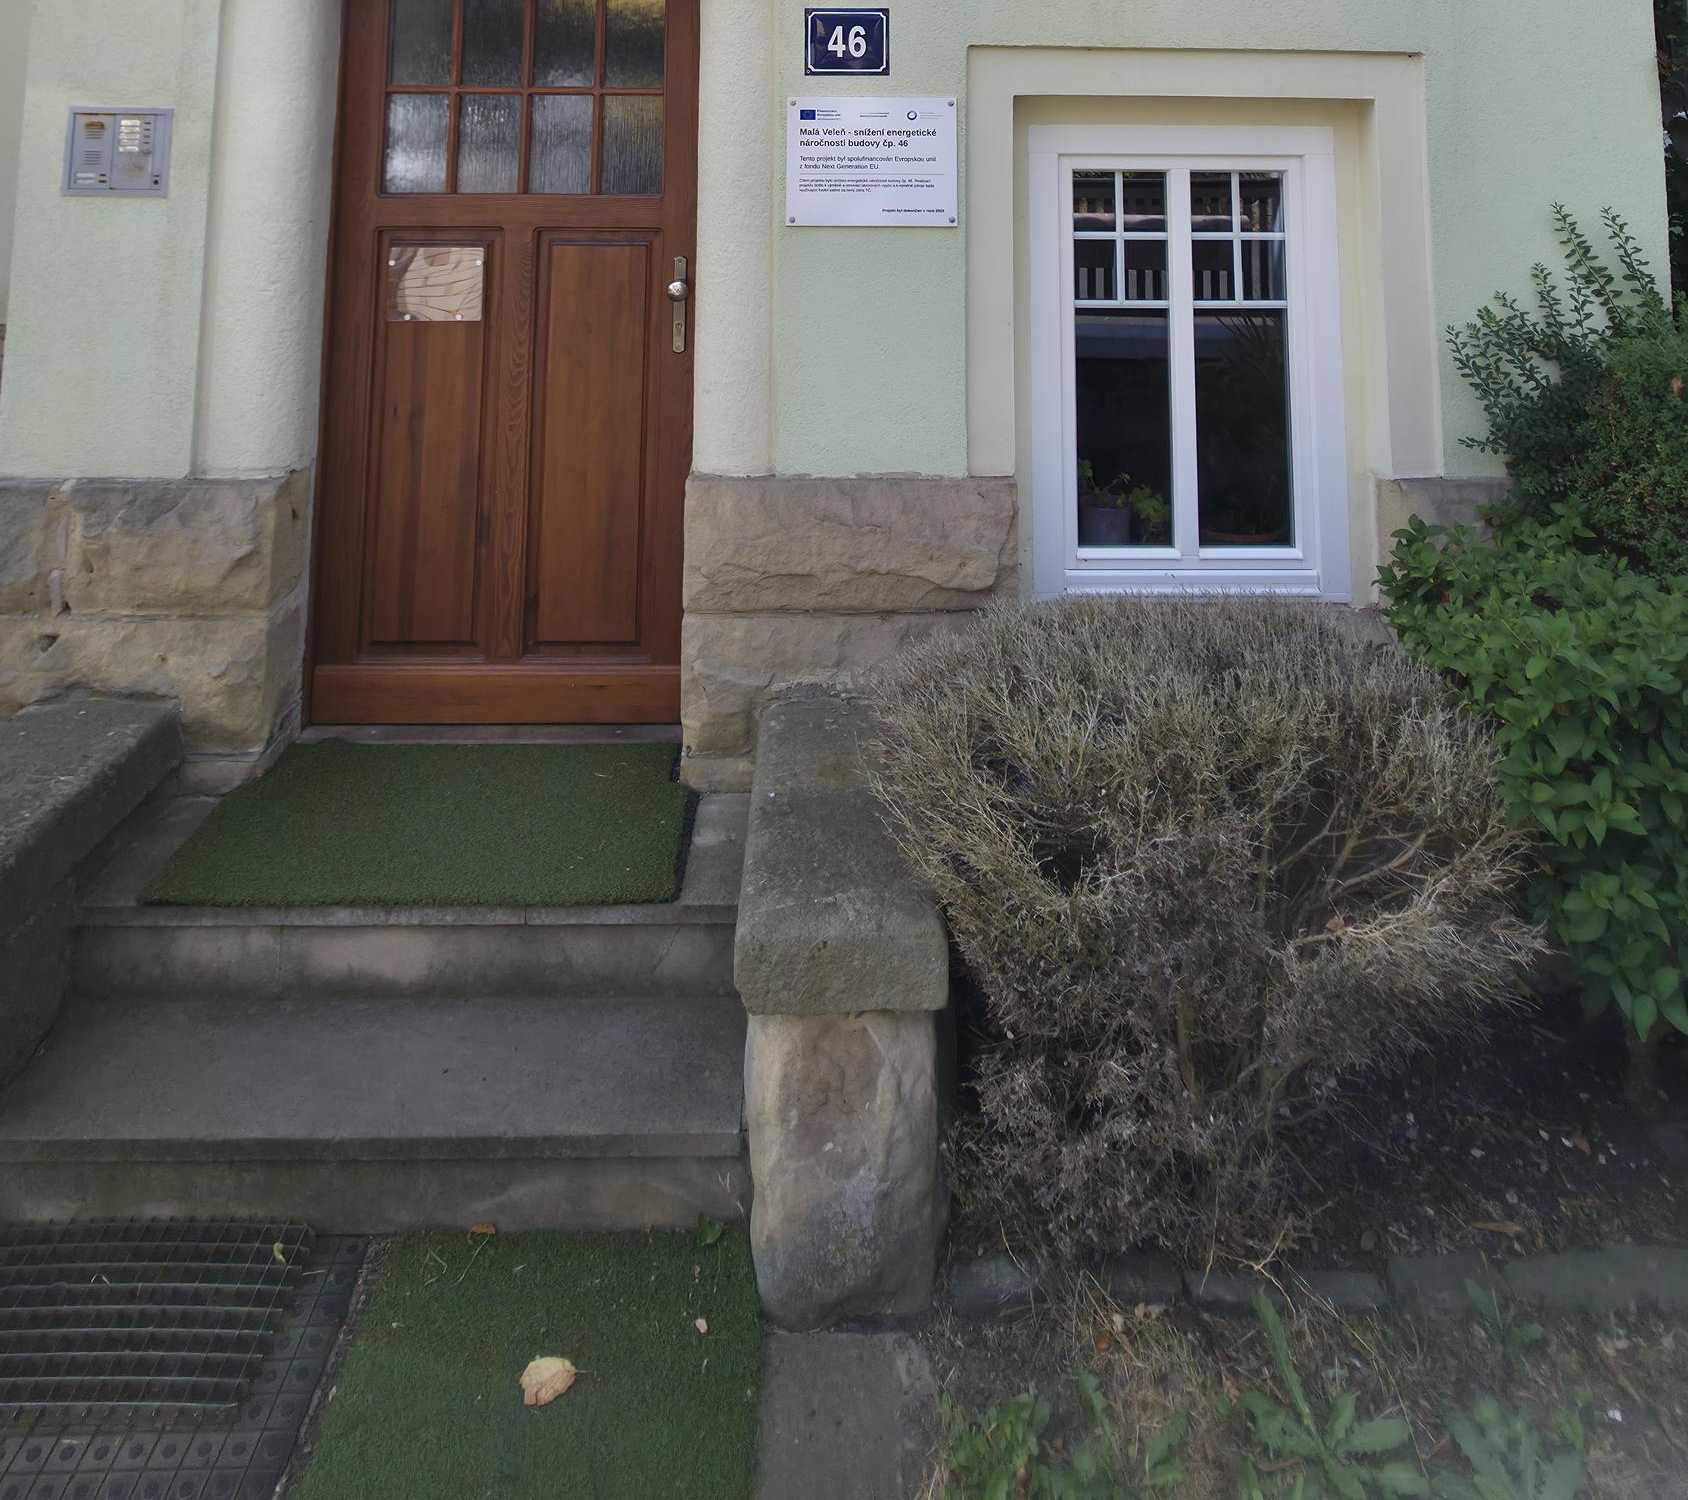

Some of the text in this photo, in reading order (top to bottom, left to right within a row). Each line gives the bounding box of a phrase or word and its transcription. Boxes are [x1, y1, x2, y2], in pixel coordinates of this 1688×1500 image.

[827, 25, 867, 58] 46
[799, 128, 820, 136] Malá
[822, 128, 846, 136] Veleň
[853, 128, 885, 137] snížení
[886, 129, 937, 138] energetické
[799, 139, 846, 147] náročnosti
[848, 139, 880, 148] budovy
[882, 140, 896, 148] čp.
